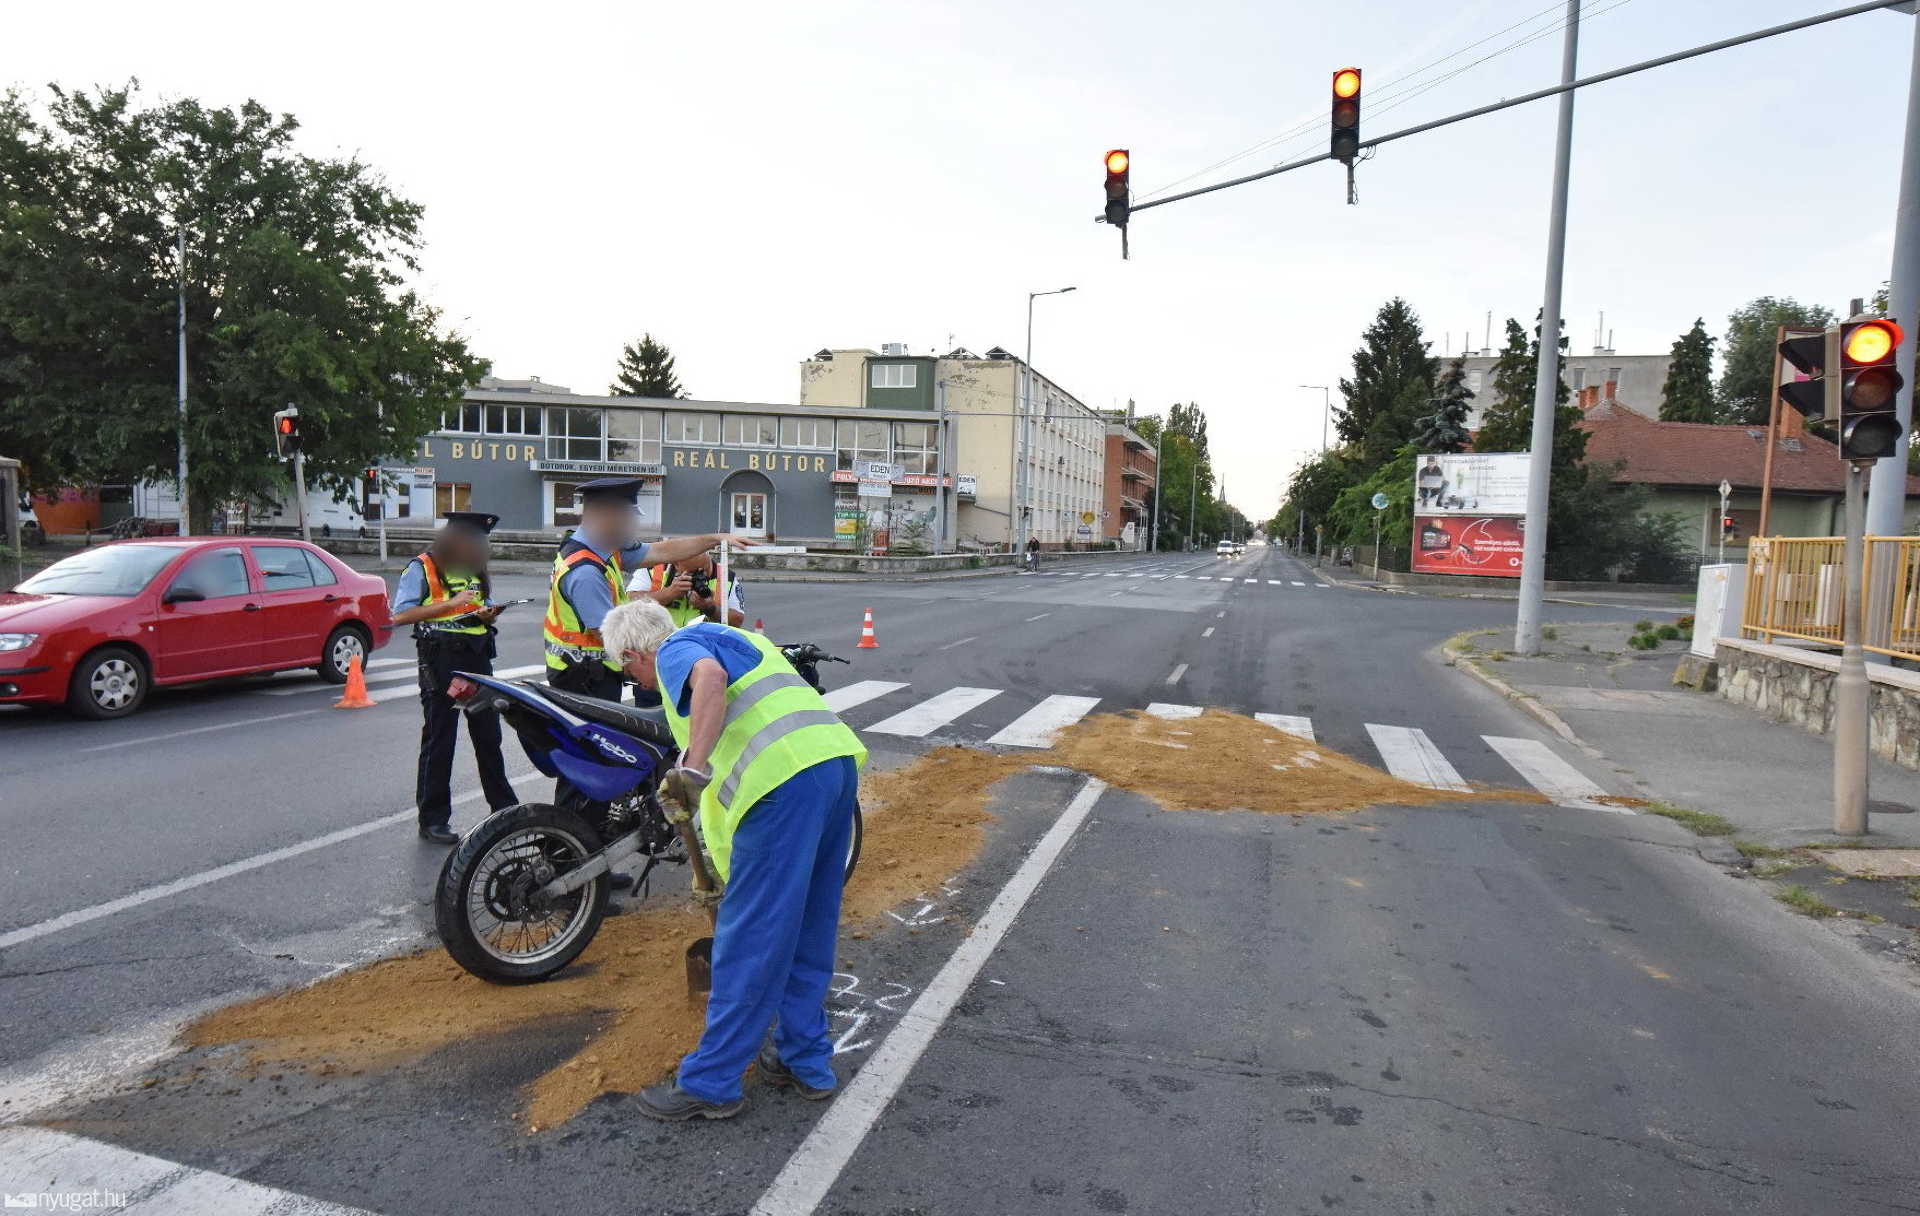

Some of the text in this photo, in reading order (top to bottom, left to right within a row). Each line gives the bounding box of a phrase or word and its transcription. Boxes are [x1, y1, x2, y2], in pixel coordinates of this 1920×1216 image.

[452, 439, 535, 461] BÚTOR
[673, 449, 825, 473] REÁL BÚTOR
[870, 464, 890, 474] EDEN
